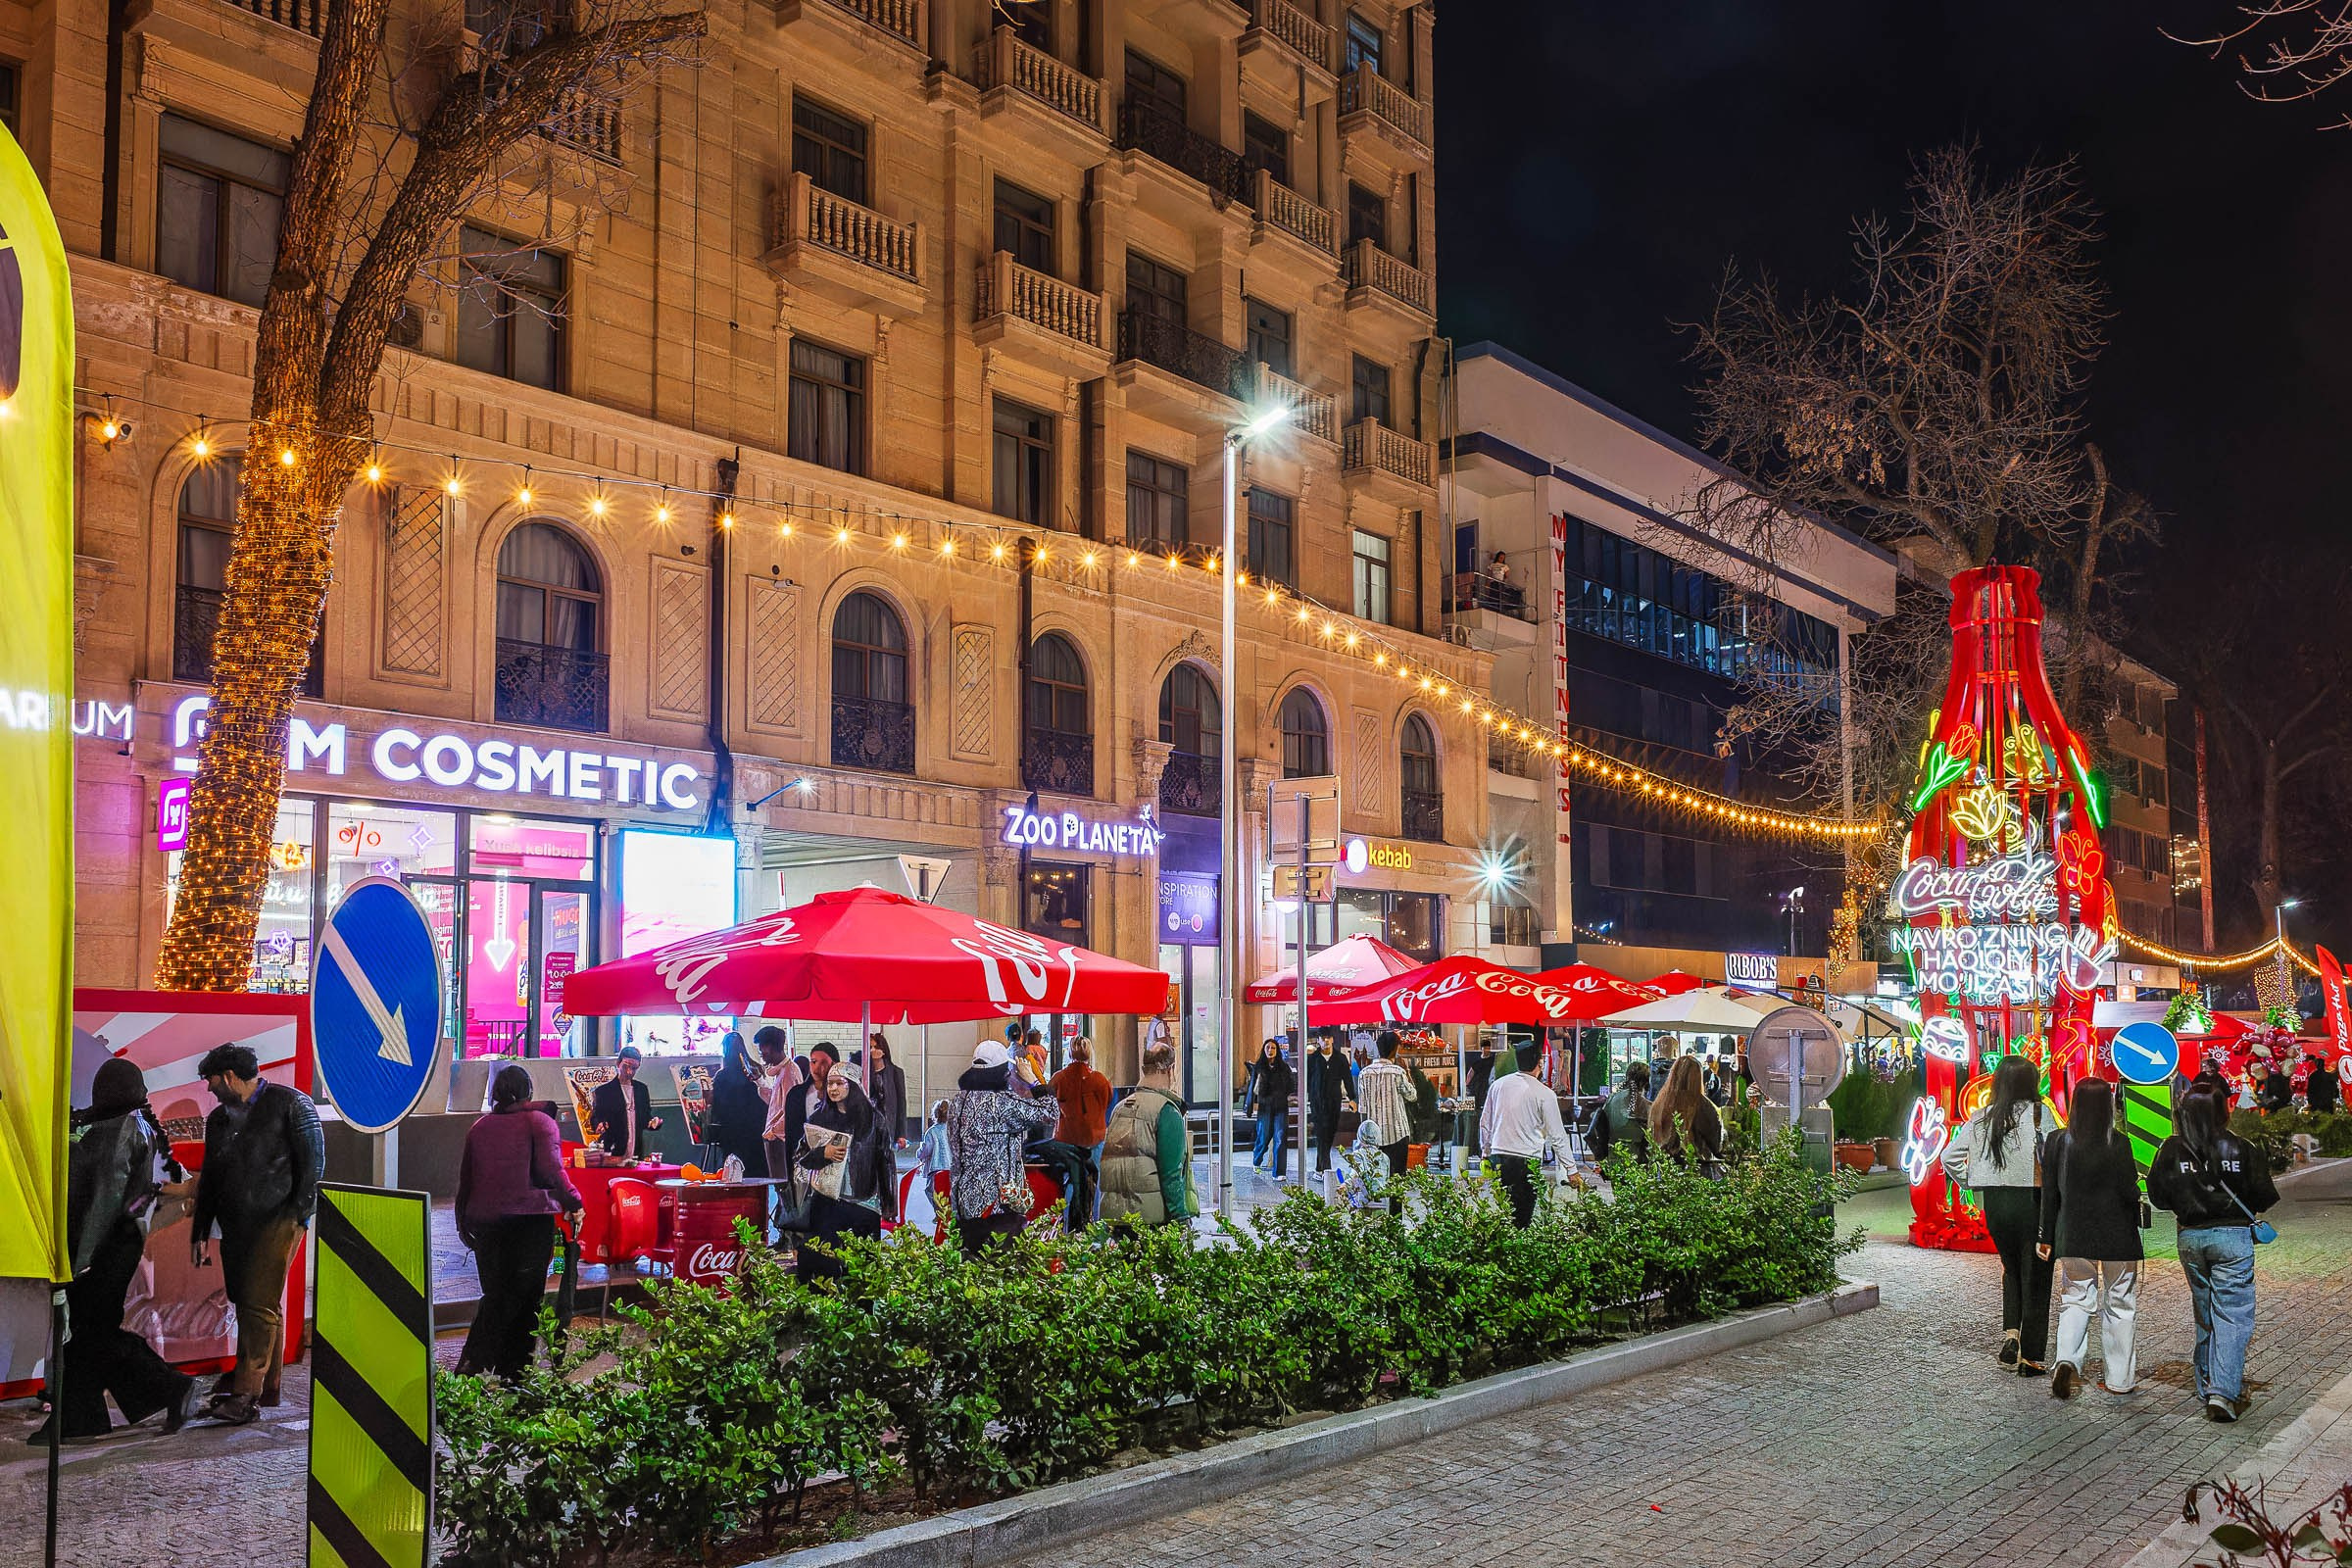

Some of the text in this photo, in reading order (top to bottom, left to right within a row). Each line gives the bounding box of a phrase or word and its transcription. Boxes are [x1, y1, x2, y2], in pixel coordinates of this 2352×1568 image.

[0, 688, 132, 740] ARUM
[372, 728, 700, 809] COSMETIC
[1005, 807, 1154, 856] ZOO PLANETA
[1368, 842, 1412, 869] kebab
[2337, 1010, 2352, 1053] Pizza
